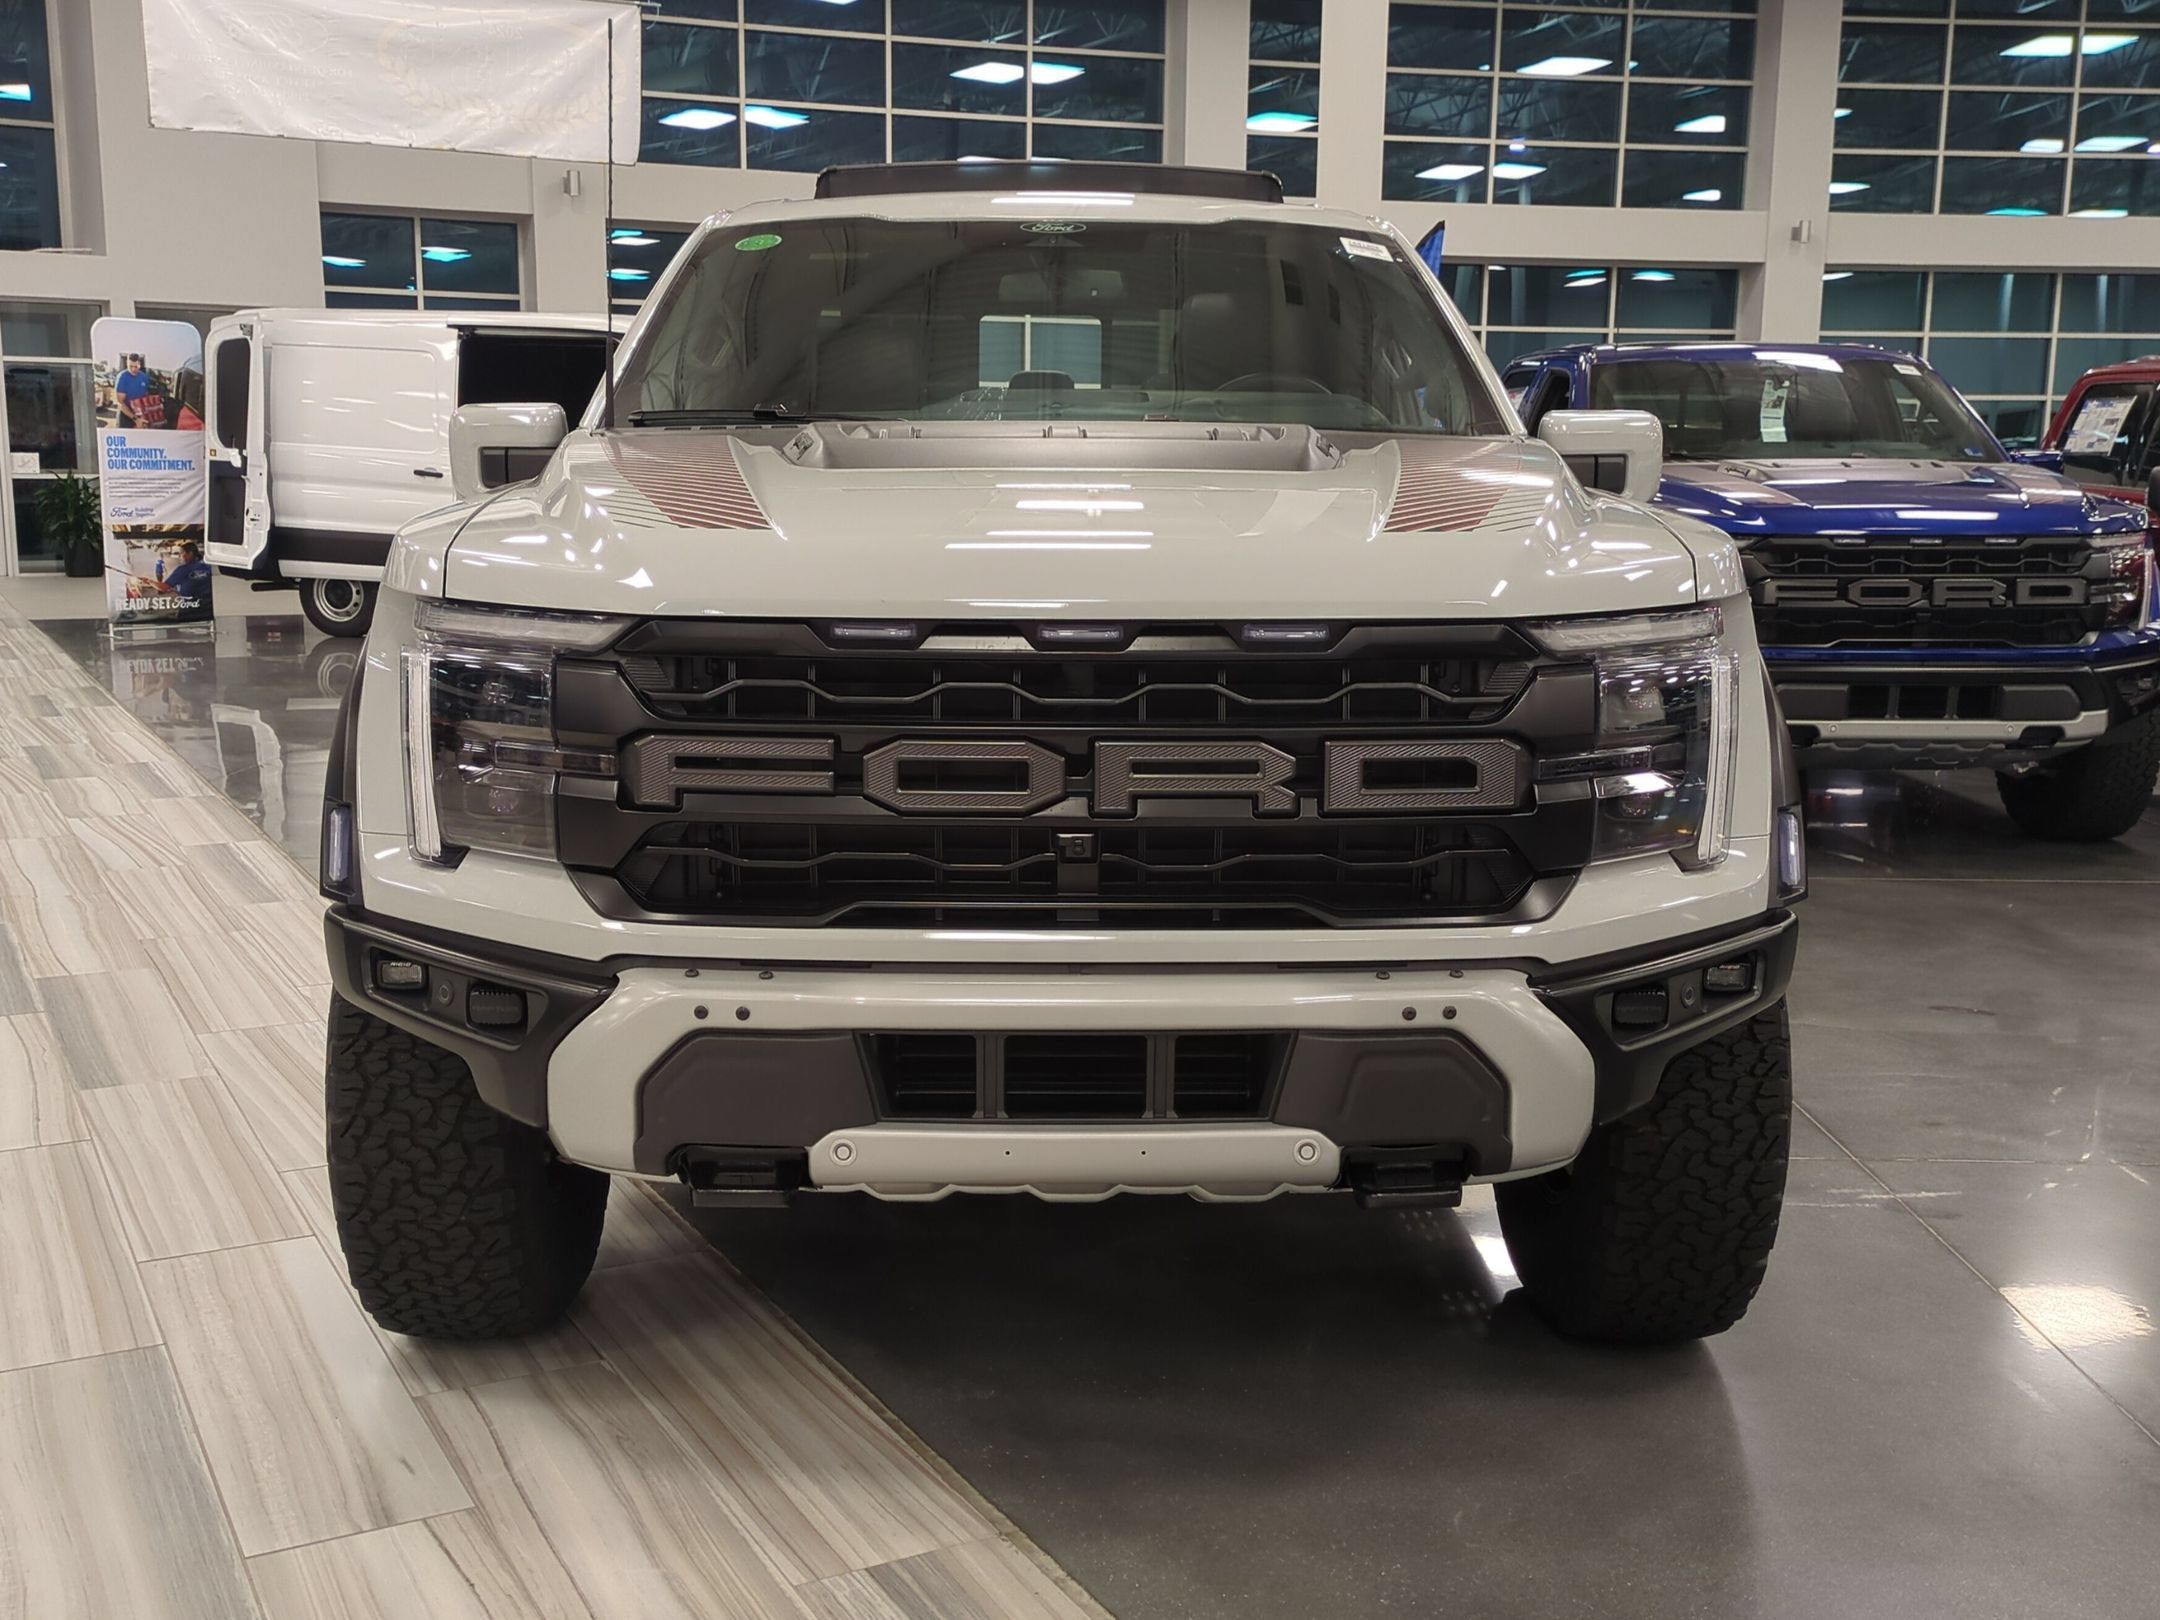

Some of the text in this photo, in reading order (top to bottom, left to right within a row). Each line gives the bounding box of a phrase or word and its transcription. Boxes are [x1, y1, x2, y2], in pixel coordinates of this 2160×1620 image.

[1031, 223, 1075, 232] Ford
[106, 436, 126, 447] OUR
[107, 447, 167, 459] COMMUNITY.
[108, 459, 196, 471] OUR COMMITMENT.
[110, 506, 133, 517] Ford
[1761, 578, 2088, 607] FORD
[152, 596, 171, 609] SET
[172, 595, 200, 609] Ford
[634, 735, 1521, 818] FORD
